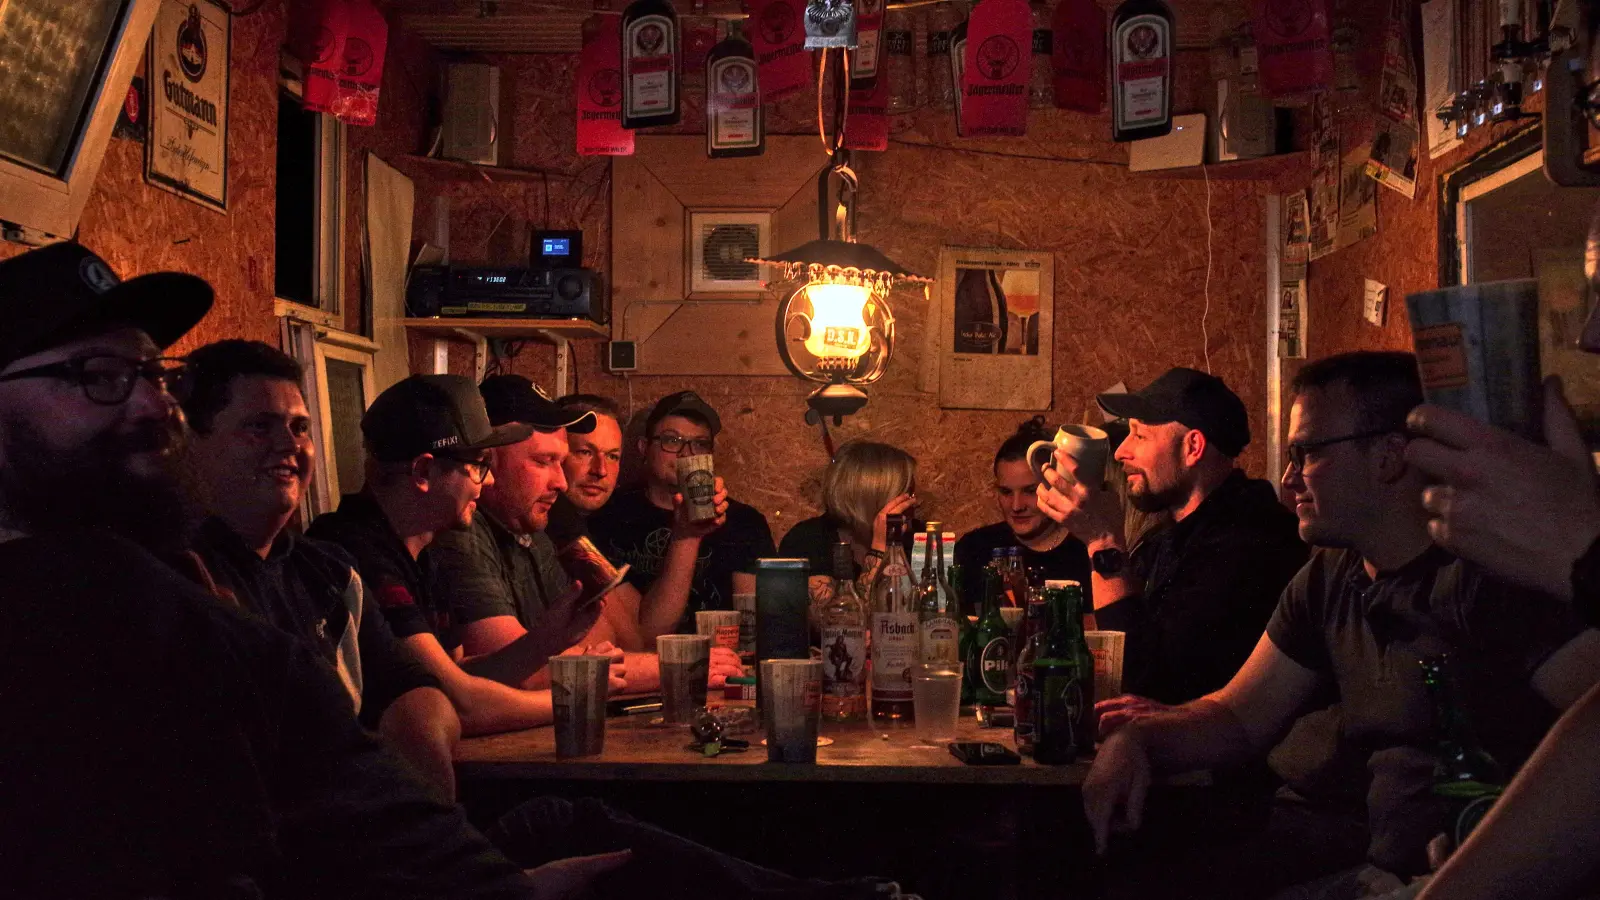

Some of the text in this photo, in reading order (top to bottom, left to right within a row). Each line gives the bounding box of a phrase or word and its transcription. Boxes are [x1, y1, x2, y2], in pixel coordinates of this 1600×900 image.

[164, 70, 217, 127] Gutmann
[581, 110, 621, 121] Jägermei
[880, 620, 915, 635] Asbach
